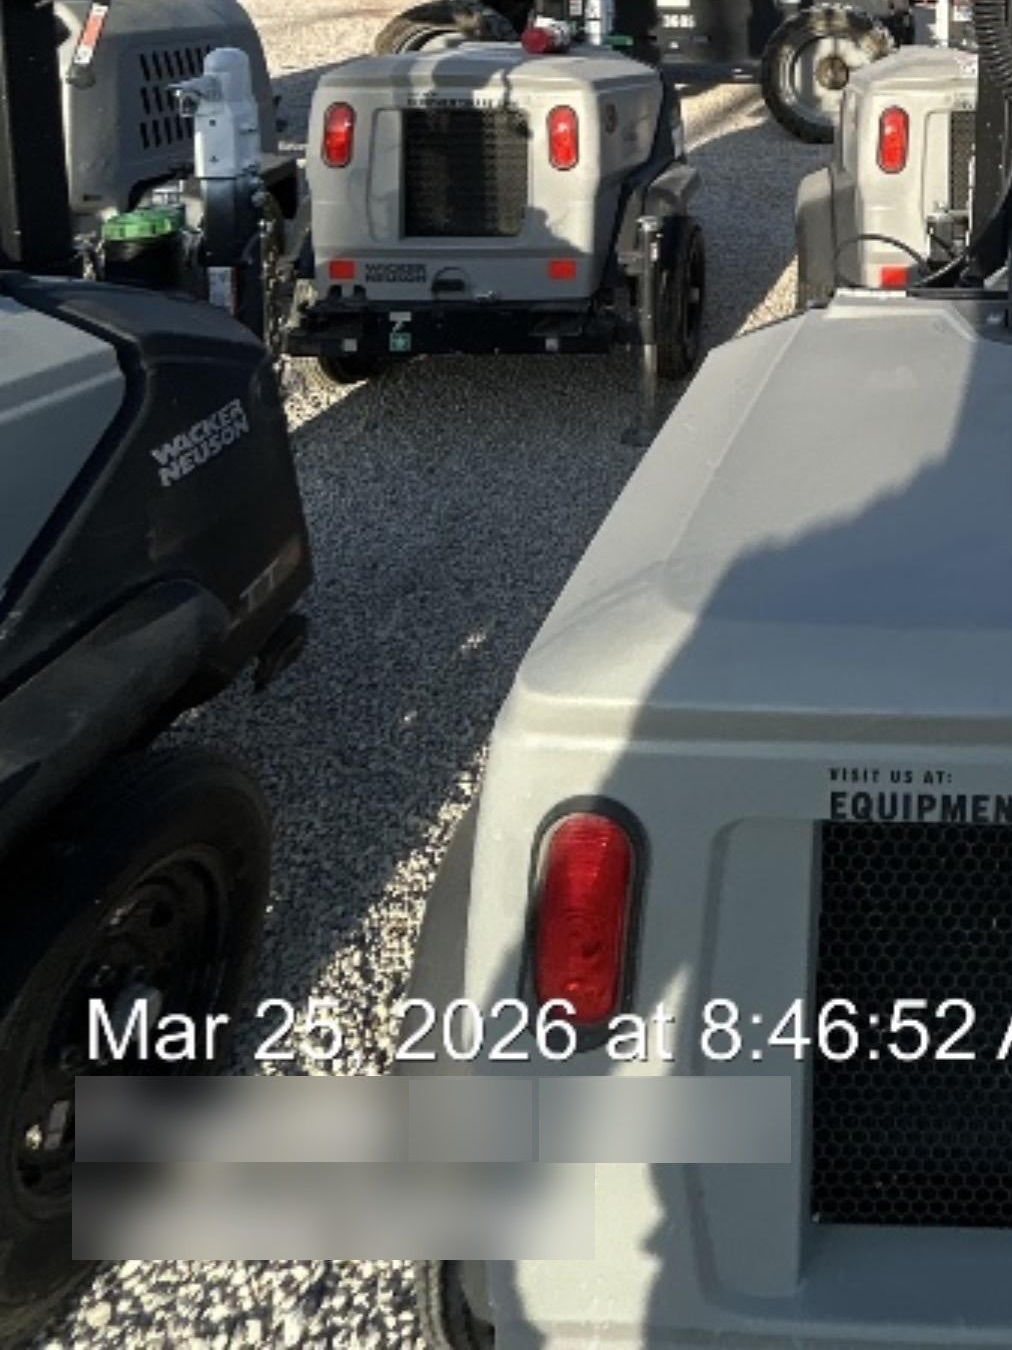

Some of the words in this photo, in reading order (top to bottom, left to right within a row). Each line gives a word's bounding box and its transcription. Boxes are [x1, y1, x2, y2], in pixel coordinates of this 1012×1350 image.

[829, 767, 881, 783] VISIT
[890, 769, 913, 784] US
[923, 769, 953, 784] AT:
